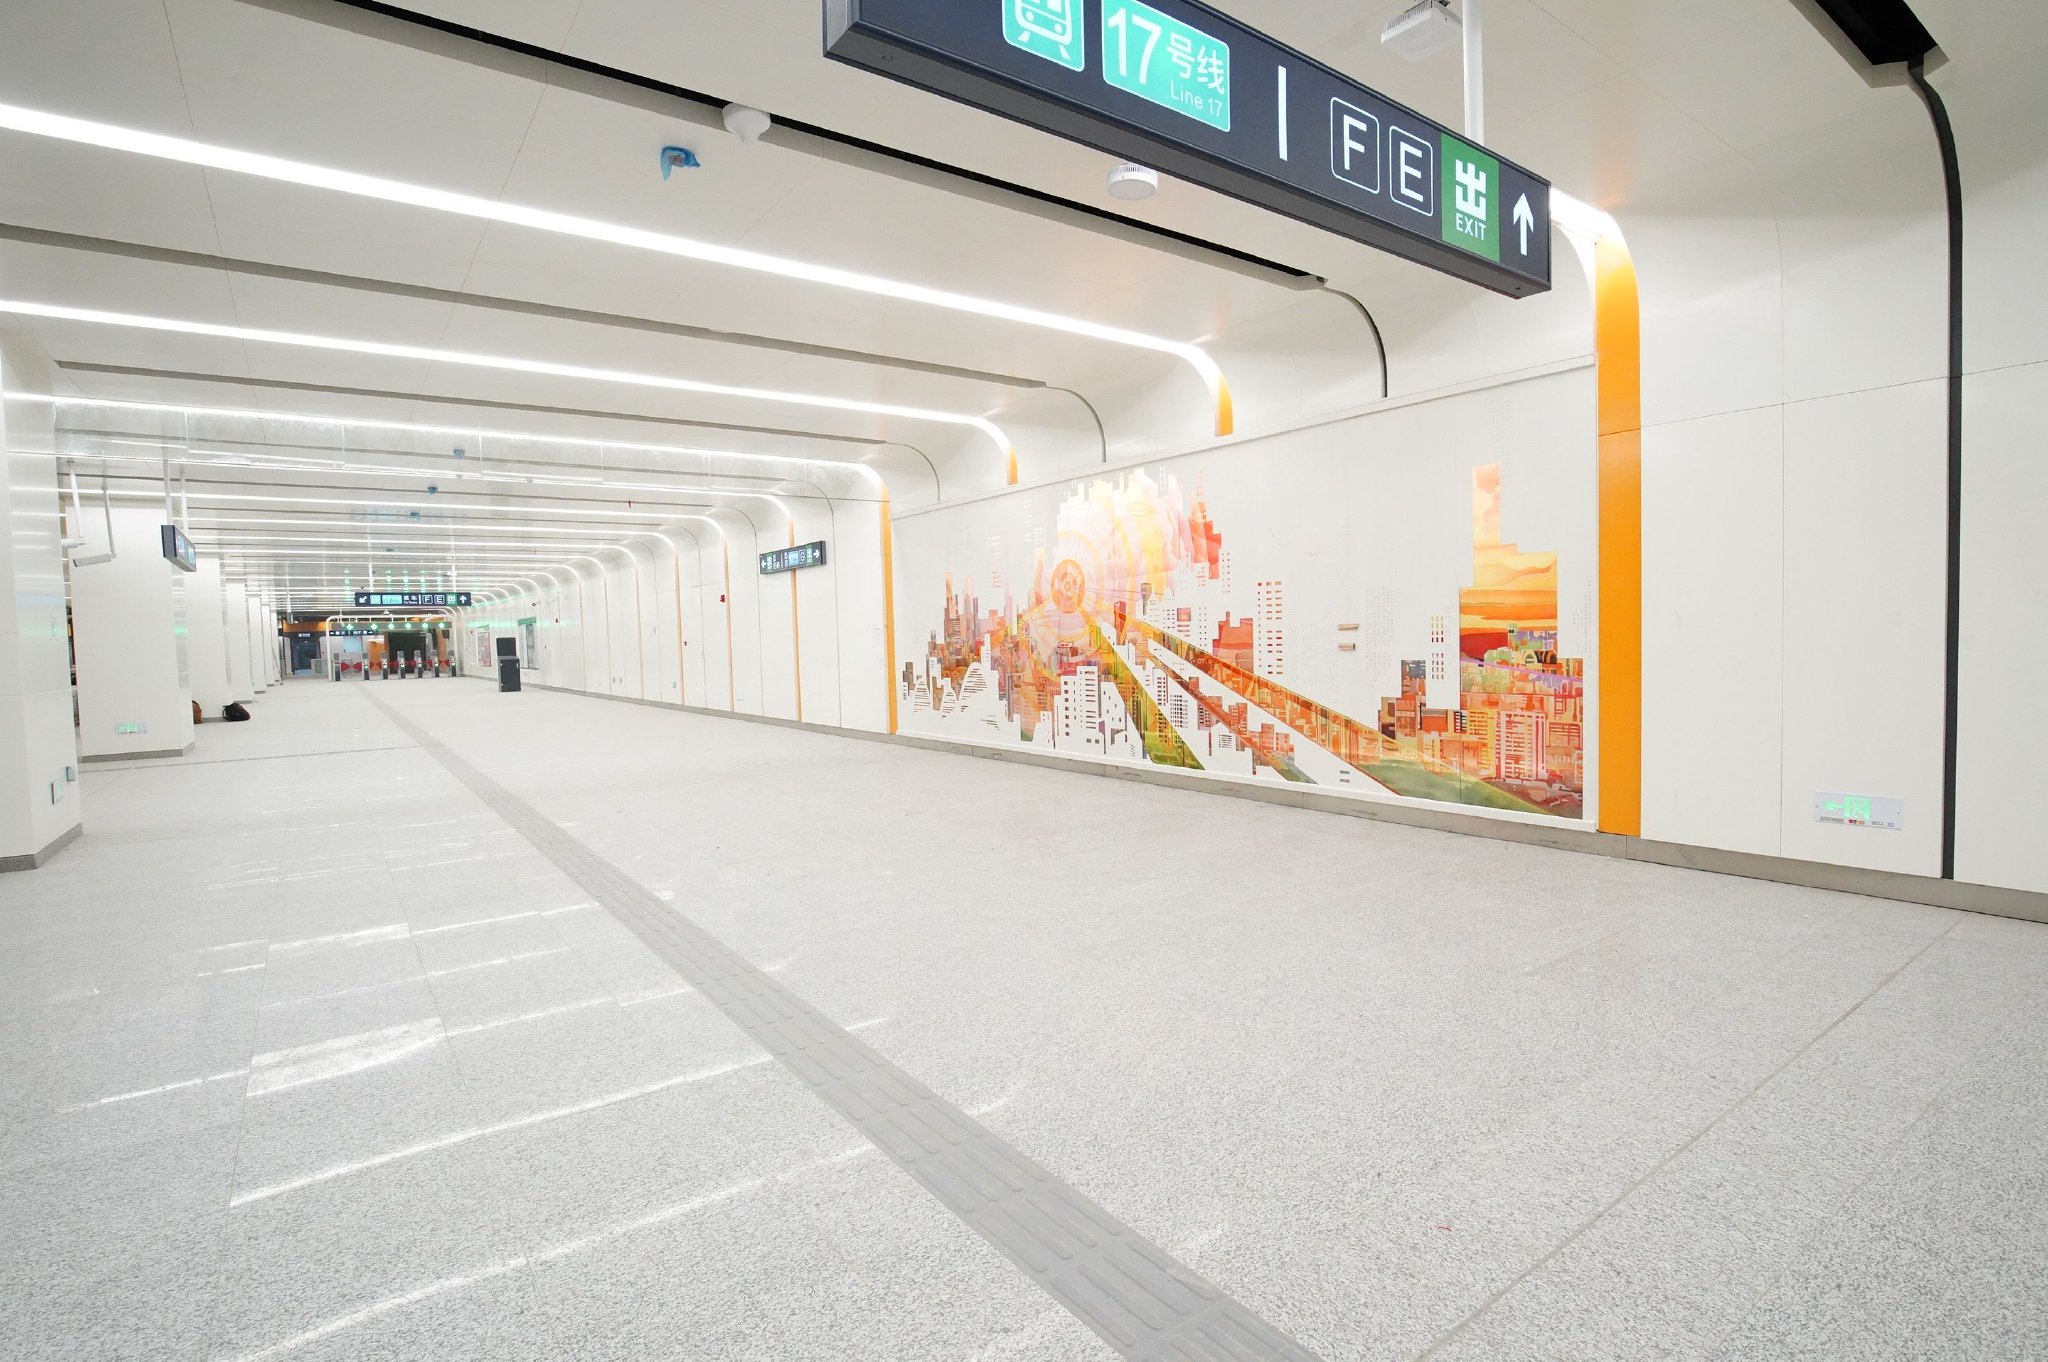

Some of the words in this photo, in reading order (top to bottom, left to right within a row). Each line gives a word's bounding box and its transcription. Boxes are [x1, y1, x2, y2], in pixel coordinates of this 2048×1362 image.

[1108, 7, 1225, 95] 17号线
[1170, 80, 1203, 110] Line
[1208, 97, 1223, 117] 17
[1343, 114, 1367, 171] F
[1399, 141, 1424, 202] E
[1455, 158, 1487, 221] 出
[1455, 212, 1487, 241] EXIT
